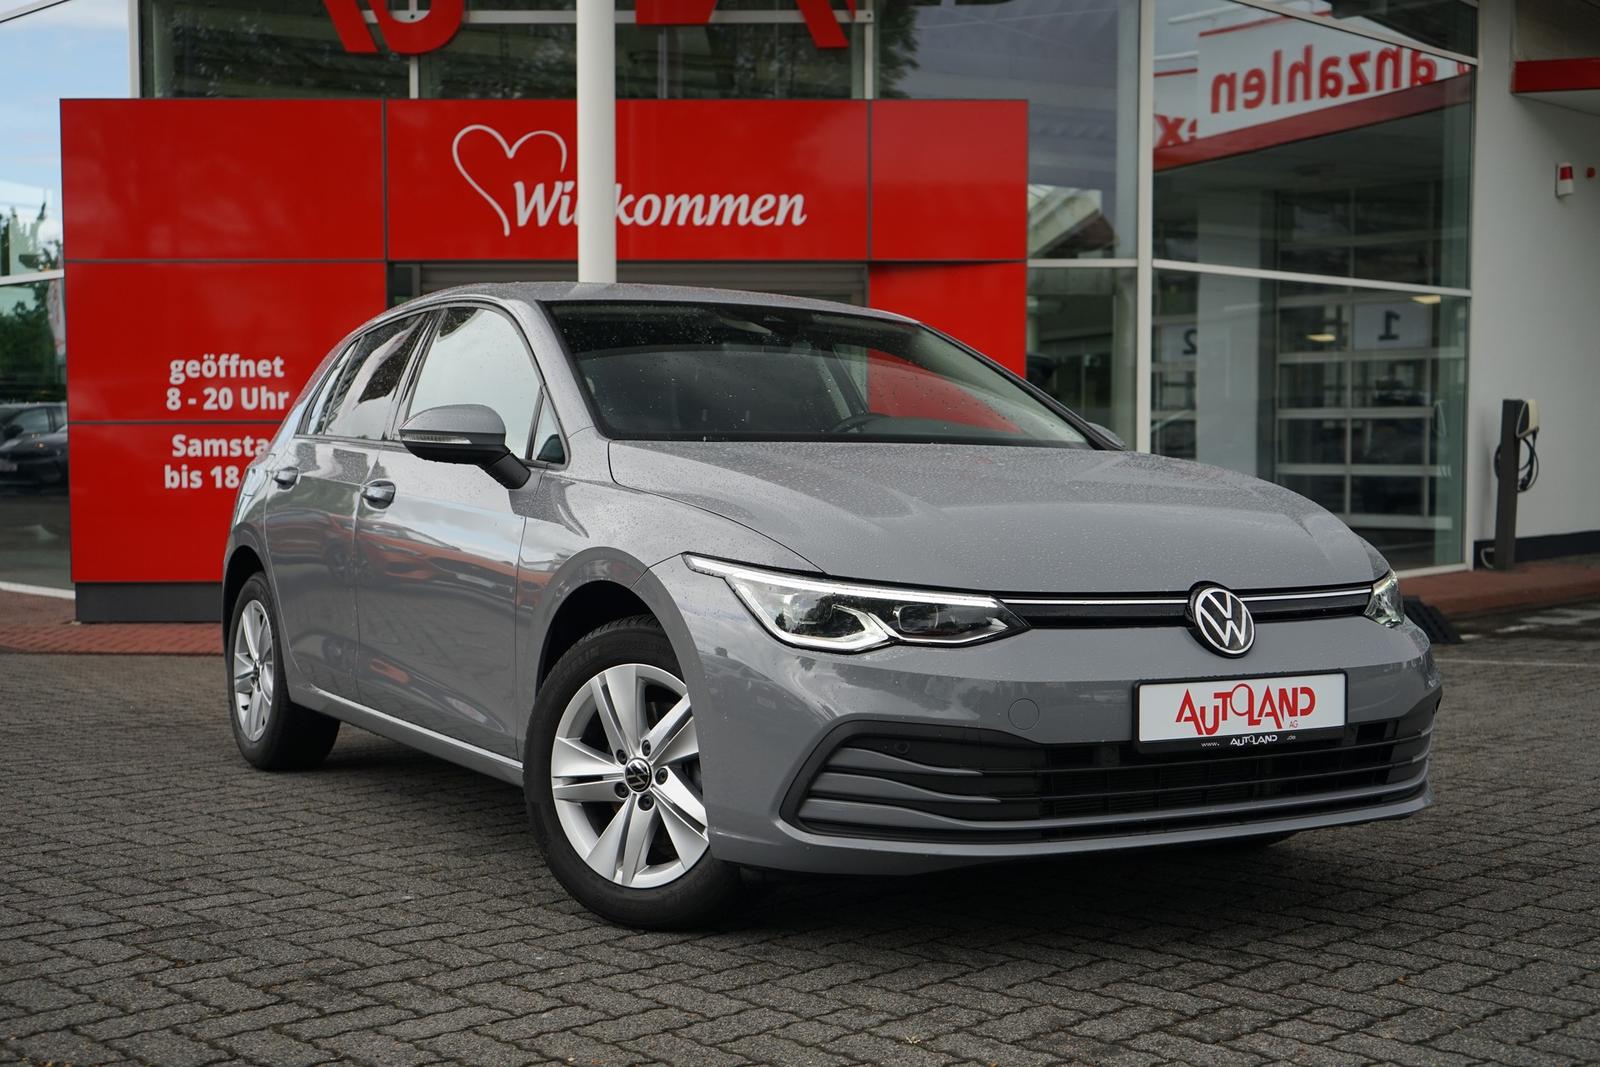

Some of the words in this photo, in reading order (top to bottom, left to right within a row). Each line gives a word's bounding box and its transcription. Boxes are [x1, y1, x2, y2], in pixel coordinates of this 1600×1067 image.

[513, 181, 807, 227] Wikommen
[169, 353, 285, 385] geöffnet
[166, 387, 181, 411] 8
[202, 387, 234, 411] 20
[240, 386, 289, 411] Uhr
[171, 434, 271, 458] Samsta
[164, 464, 202, 489] bis
[210, 465, 240, 489] 18
[1175, 683, 1316, 736] AUTOLAND
[1289, 720, 1299, 729] AG
[1229, 734, 1278, 747] AUTOLAND
